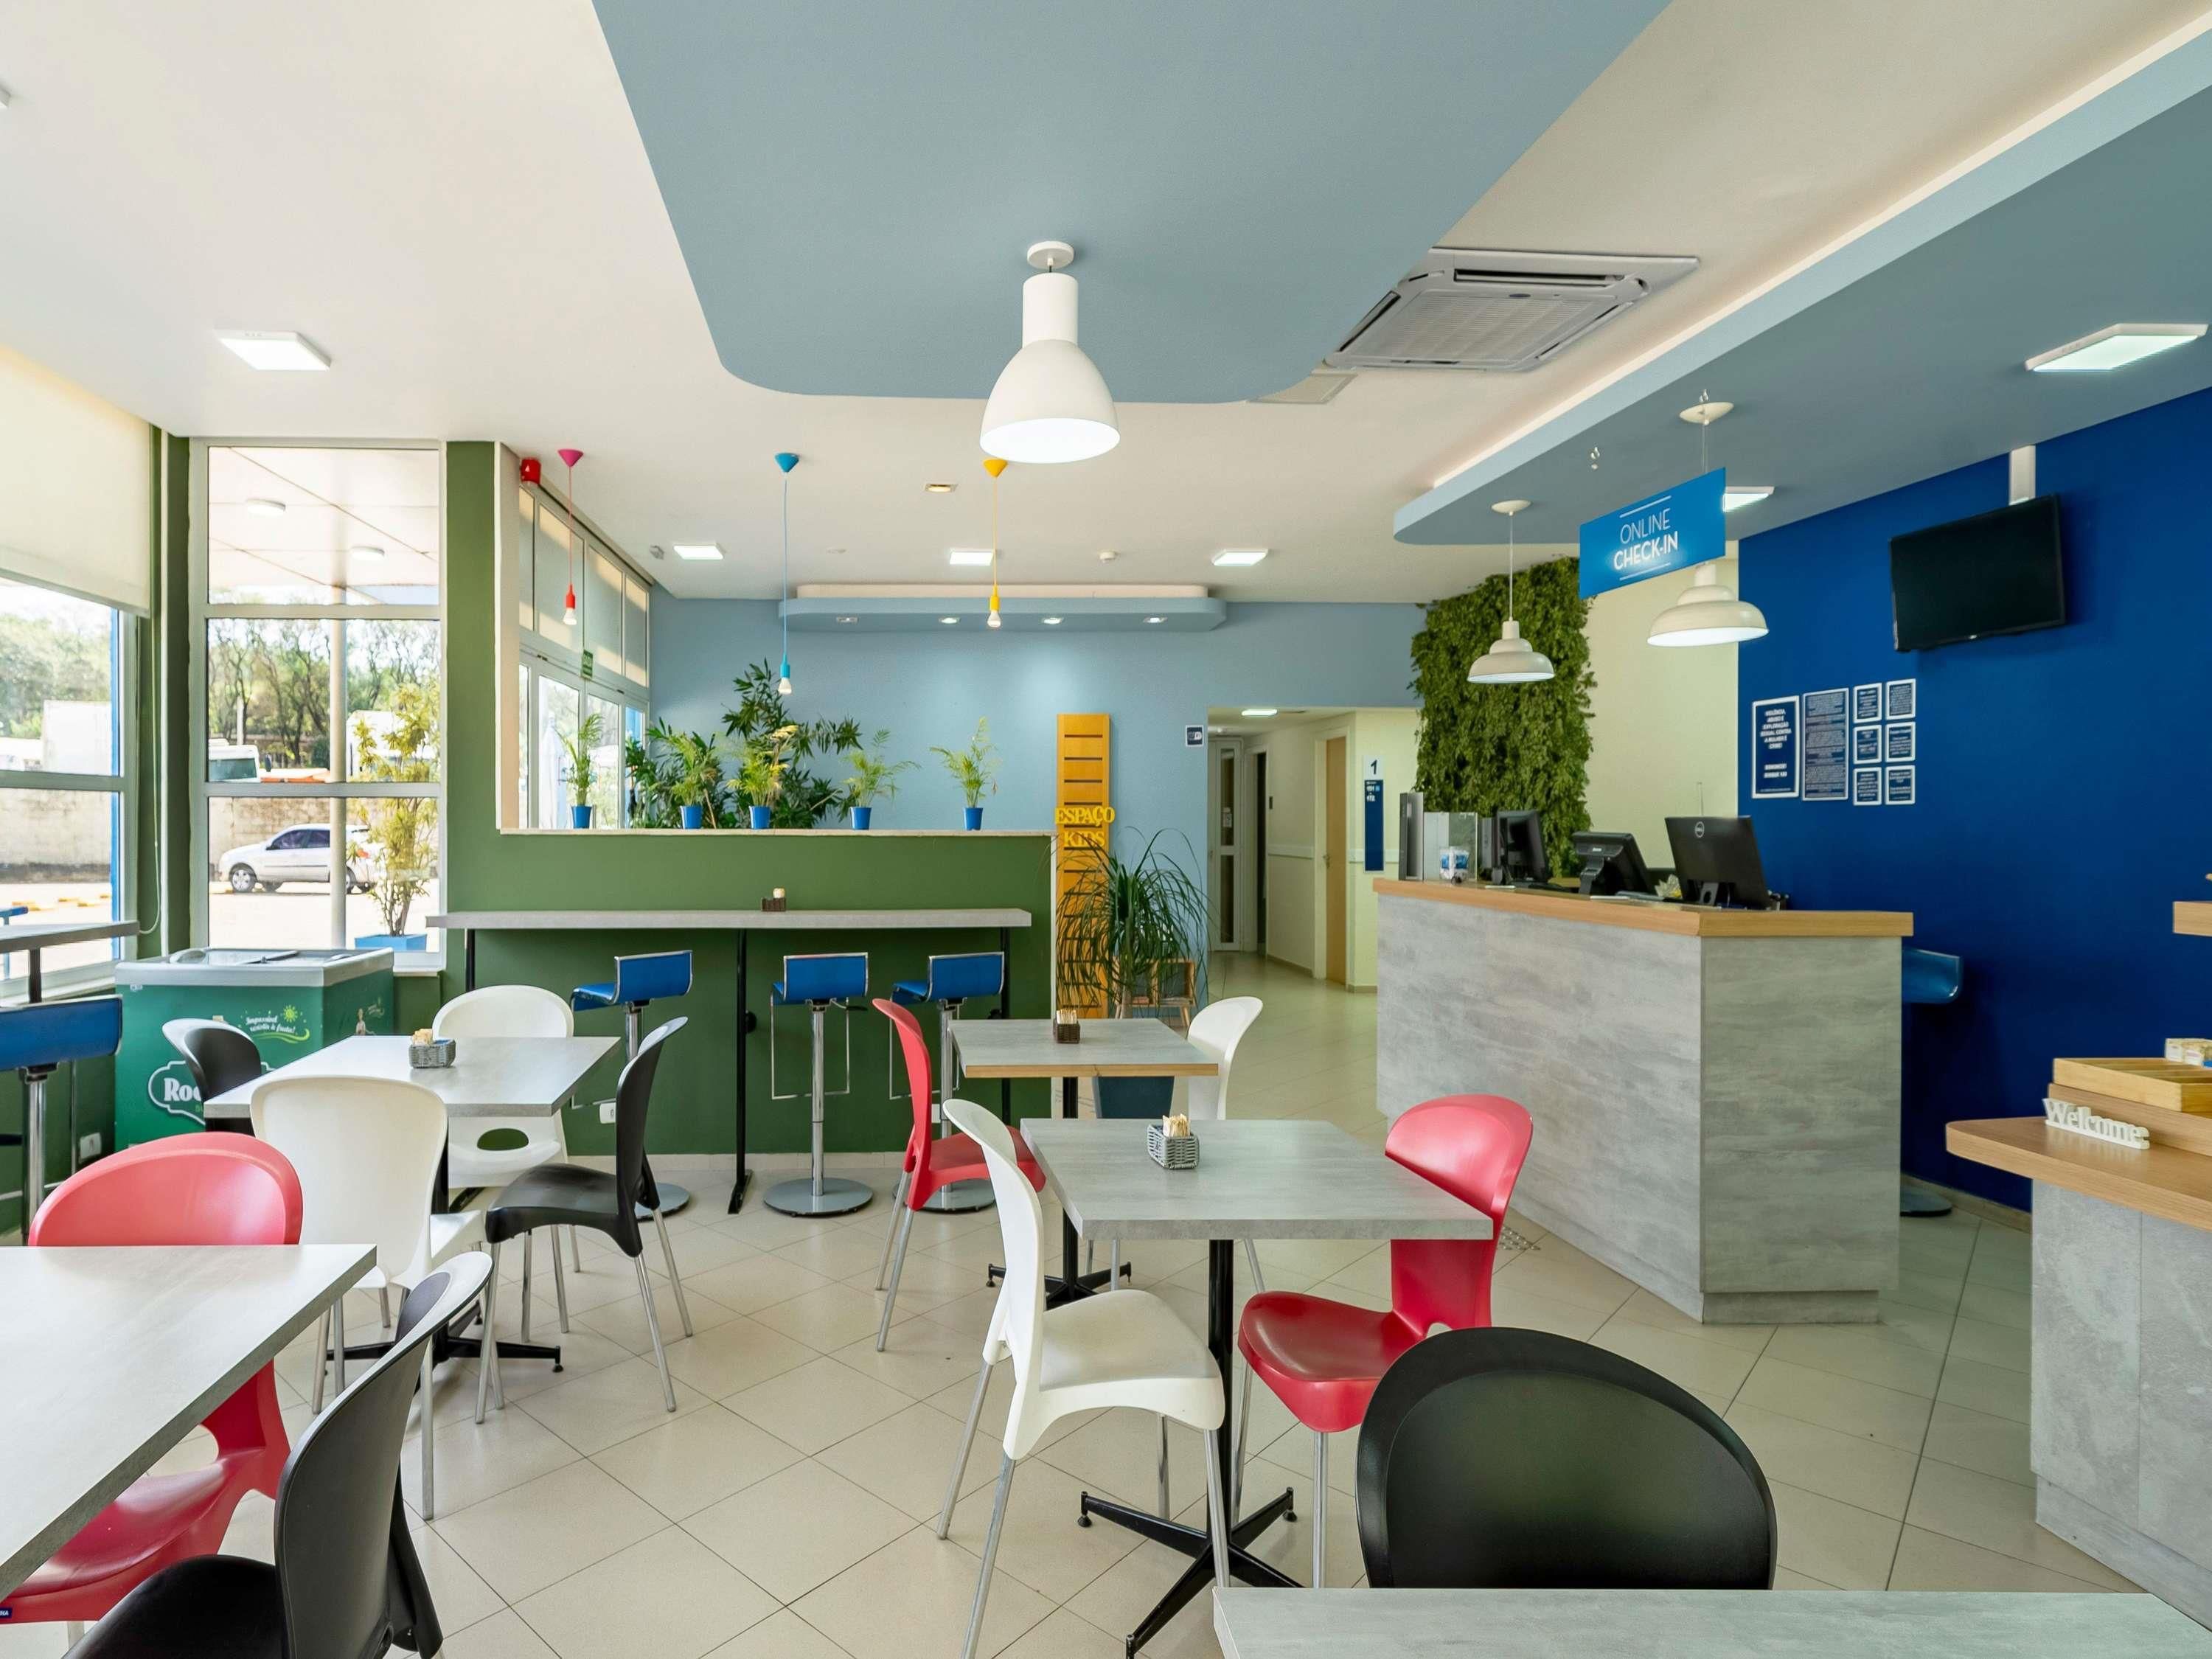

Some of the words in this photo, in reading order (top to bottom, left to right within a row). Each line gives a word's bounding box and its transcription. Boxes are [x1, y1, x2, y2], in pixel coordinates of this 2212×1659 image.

[1620, 508, 1671, 544] ONLINE
[1613, 531, 1678, 570] CHECK-IN
[1371, 759, 1377, 775] 1
[1055, 805, 1116, 827] ESPAÇO
[1064, 831, 1105, 846] KIDS
[2042, 1098, 2149, 1147] Welcome
